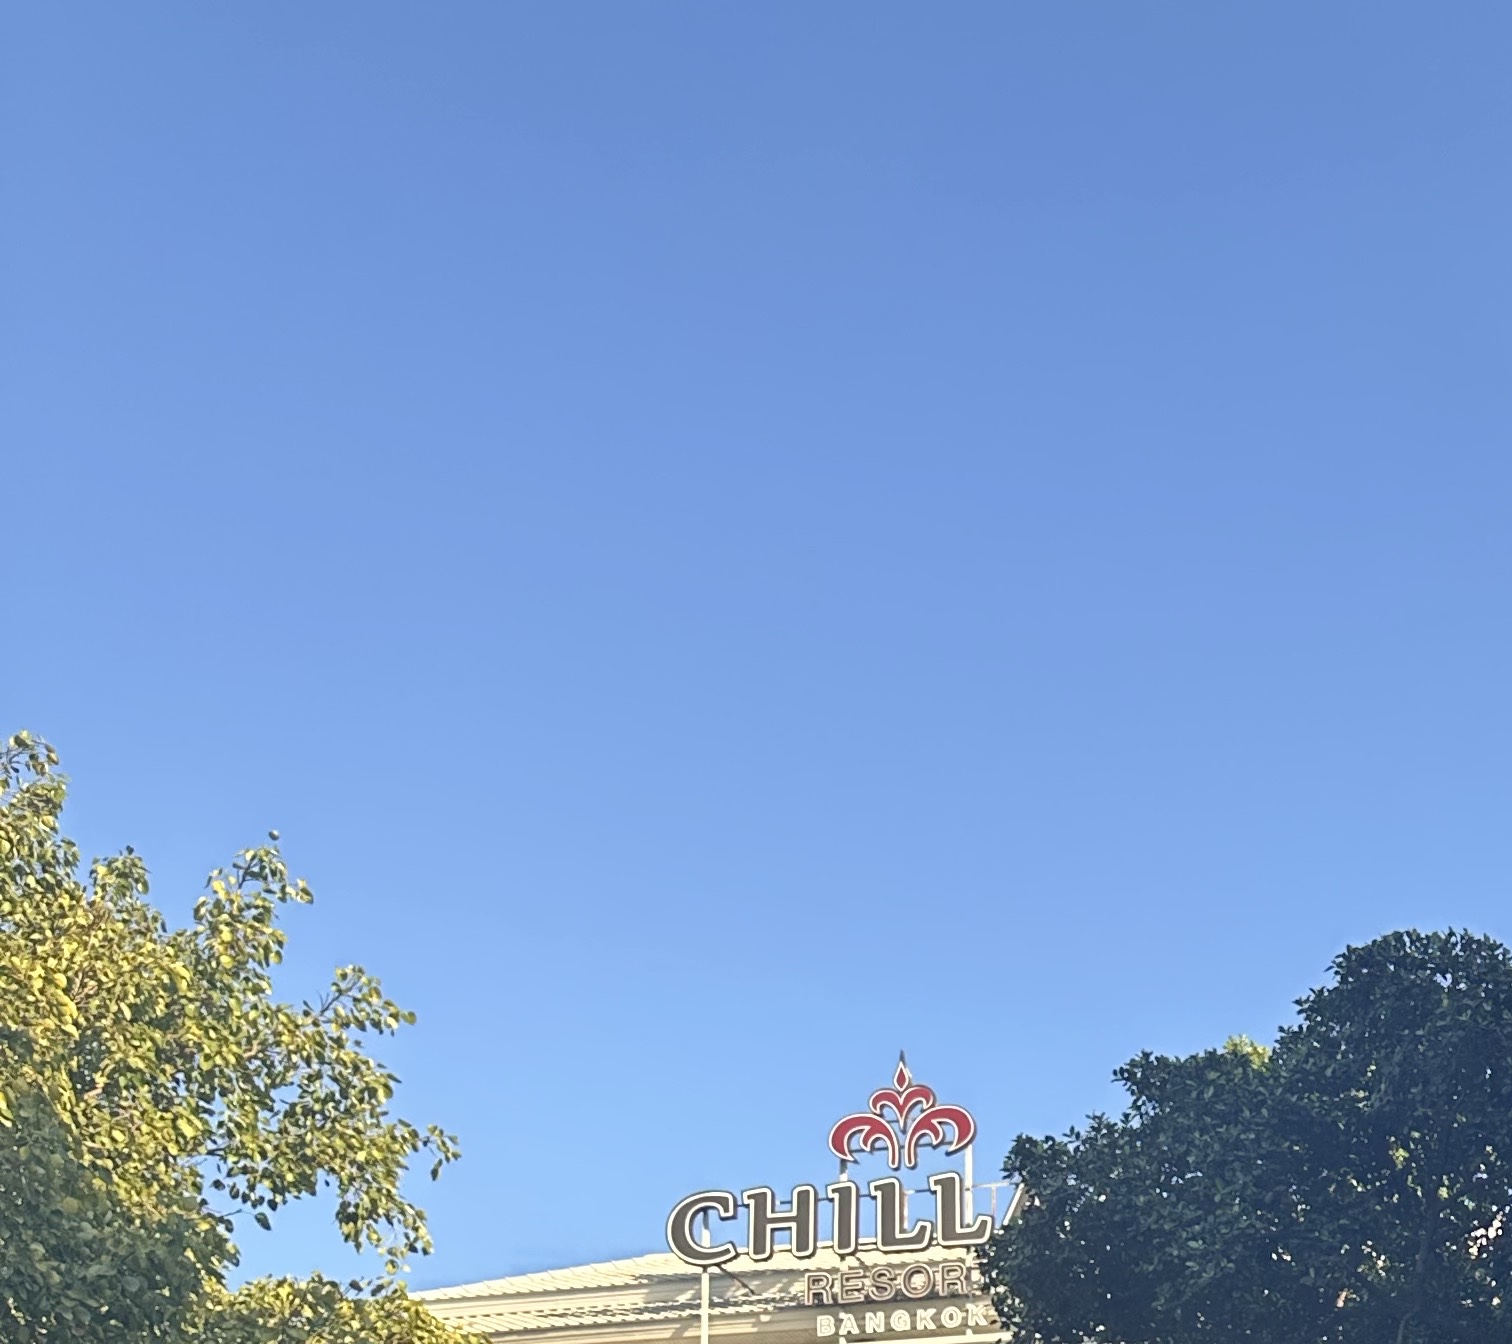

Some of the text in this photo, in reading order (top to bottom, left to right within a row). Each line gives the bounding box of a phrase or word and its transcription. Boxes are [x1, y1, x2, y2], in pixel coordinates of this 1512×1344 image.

[667, 1172, 1030, 1266] CHILL
[804, 1263, 984, 1305] RESOR
[816, 1304, 989, 1337] BANGKOK
